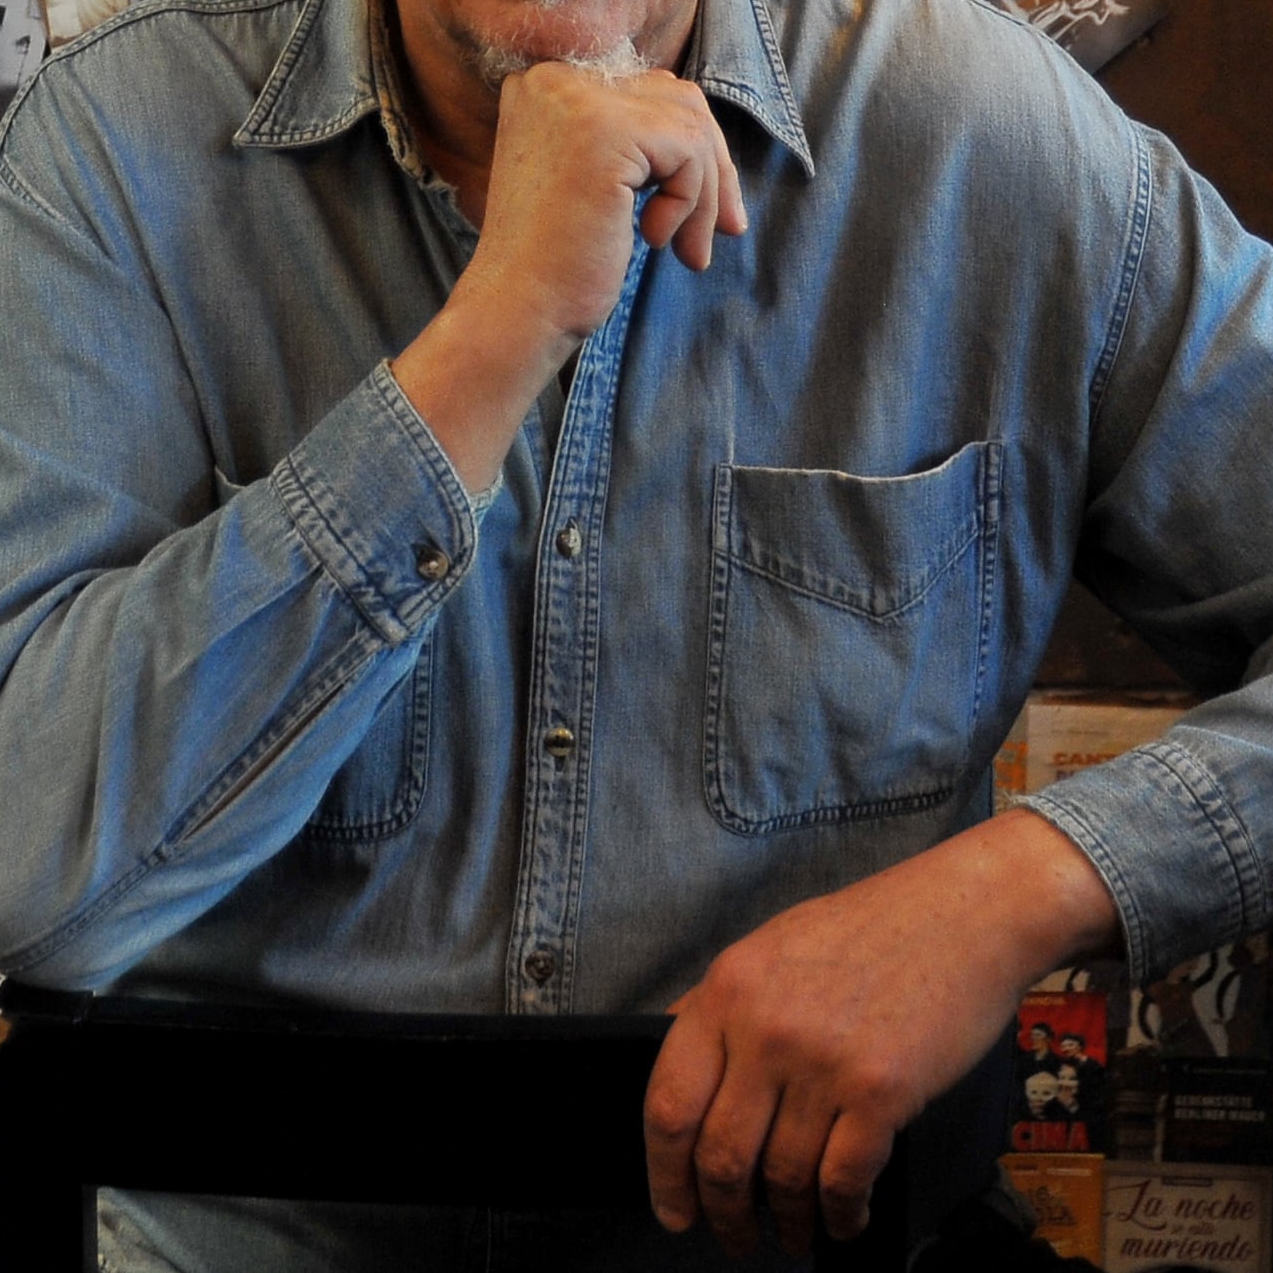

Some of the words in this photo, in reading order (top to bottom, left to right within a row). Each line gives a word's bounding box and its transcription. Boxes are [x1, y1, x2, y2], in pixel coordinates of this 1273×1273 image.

[1108, 1180, 1167, 1231] La
[1176, 1194, 1256, 1222] noche
[1120, 1234, 1253, 1261] muriendo
